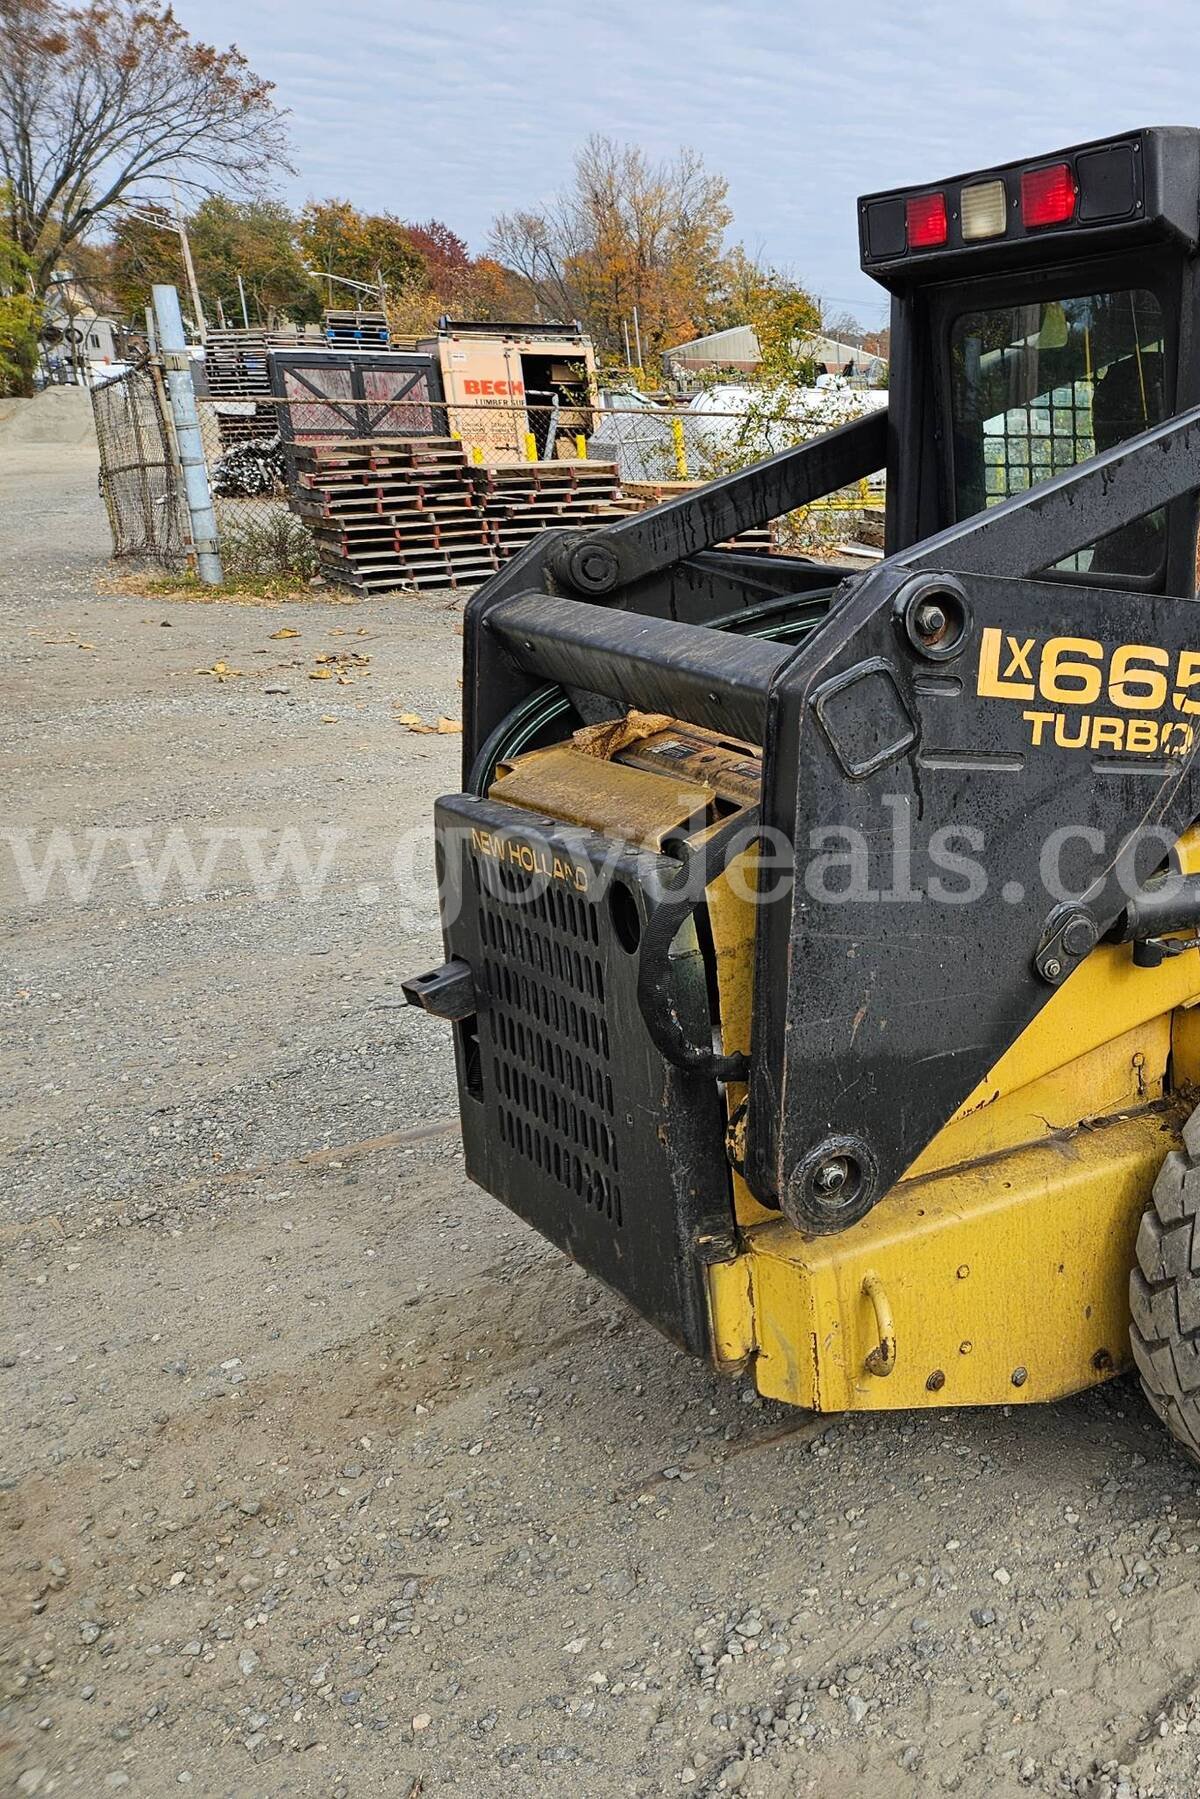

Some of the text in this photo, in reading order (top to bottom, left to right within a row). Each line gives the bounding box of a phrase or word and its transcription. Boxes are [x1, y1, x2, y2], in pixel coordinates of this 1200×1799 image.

[1023, 711, 1194, 755] TURBO
[471, 827, 588, 893] NEW HOLLAND
